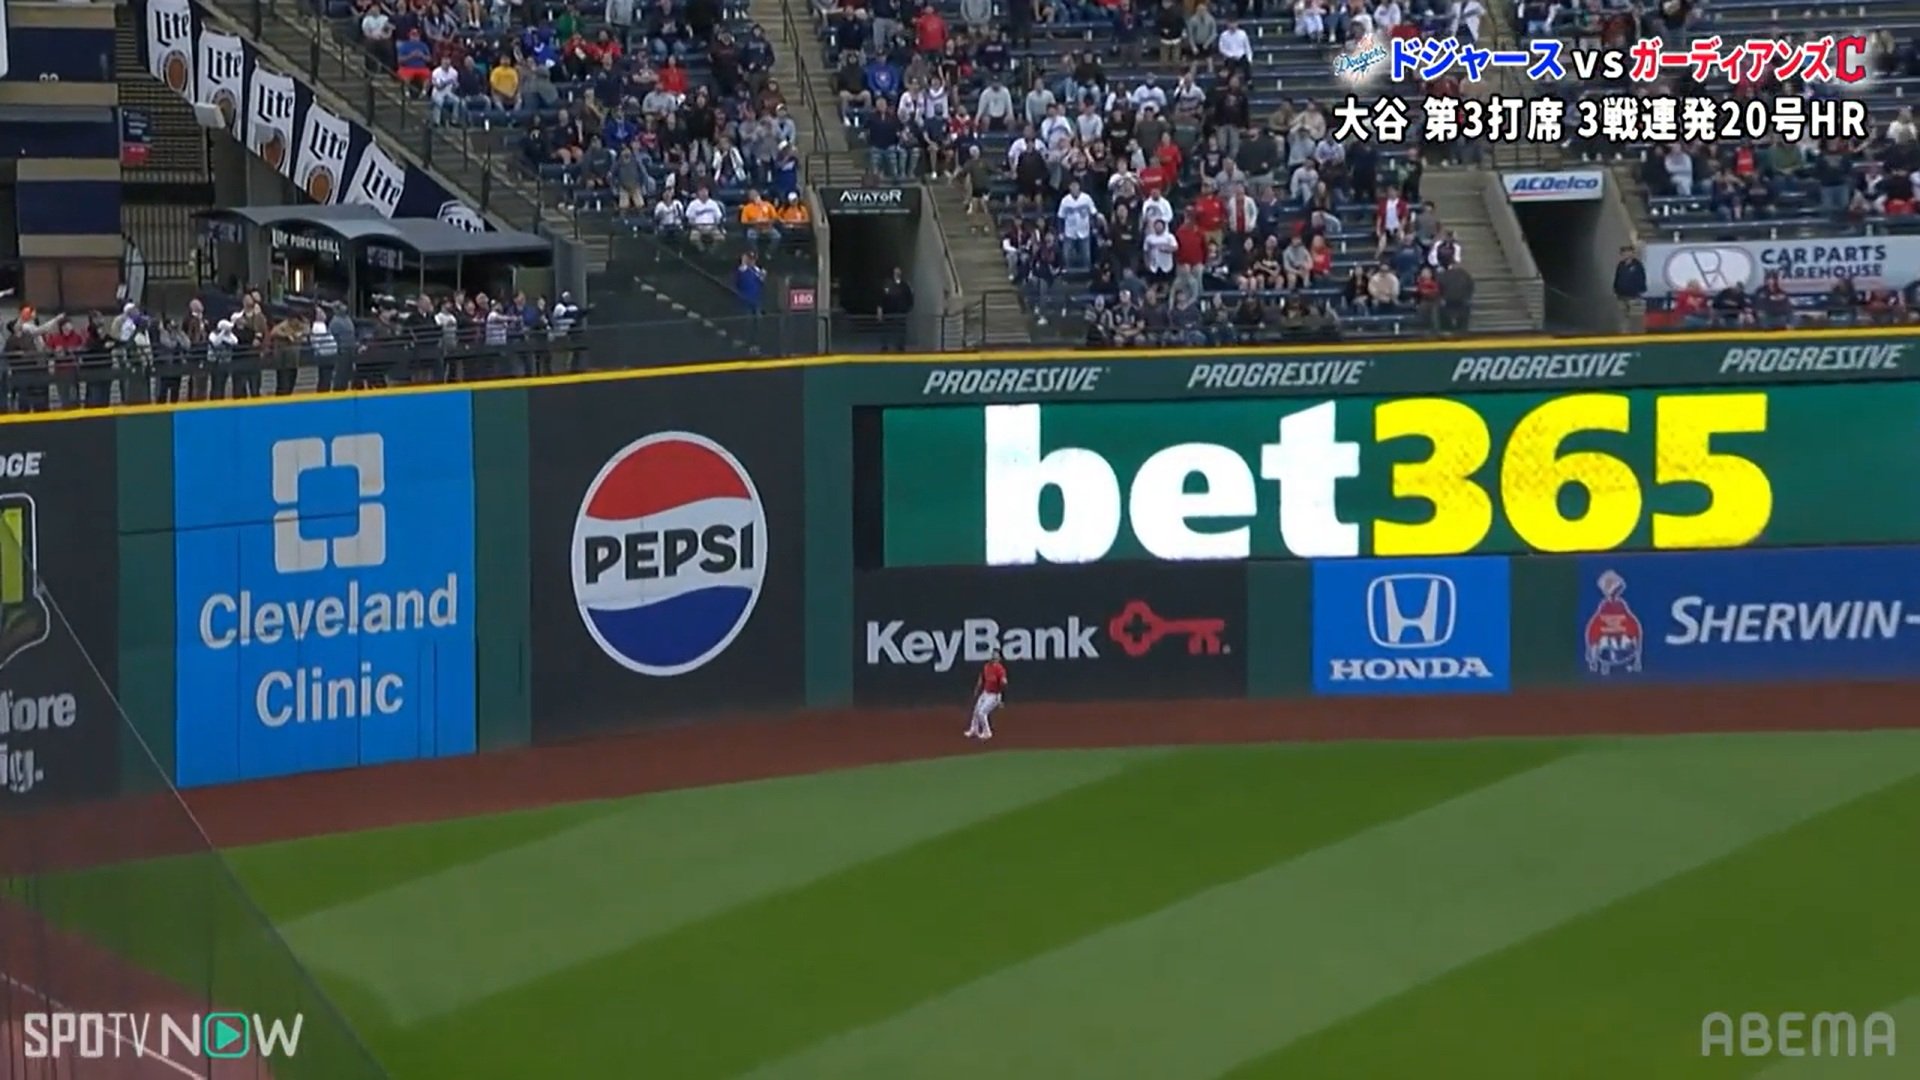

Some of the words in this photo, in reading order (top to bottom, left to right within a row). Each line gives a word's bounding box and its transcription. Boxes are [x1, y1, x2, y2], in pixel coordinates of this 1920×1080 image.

[156, 11, 190, 47] Lite
[207, 47, 242, 84] Lite
[258, 85, 293, 122] Lite
[310, 120, 348, 160] Lite
[362, 161, 402, 206] Lite
[840, 190, 901, 202] AVIATOR
[1512, 175, 1599, 192] ACDelco
[291, 235, 316, 250] PORCH
[1761, 248, 1808, 264] CAR
[1813, 245, 1887, 262] PARTS
[1187, 361, 1362, 388] PROGRESSIVE
[1452, 354, 1628, 381] PROGRESSIVE
[1720, 346, 1902, 373] PROGRESSIVE
[922, 368, 1100, 394] PROGRESSIVE
[986, 392, 1772, 566] bet365
[584, 524, 755, 584] PEPSI
[199, 573, 458, 649] Cleveland
[1666, 596, 1920, 646] SHERWIN-
[867, 616, 1098, 672] KeyBank
[1329, 656, 1493, 680] HONDA
[256, 662, 403, 727] Clinic
